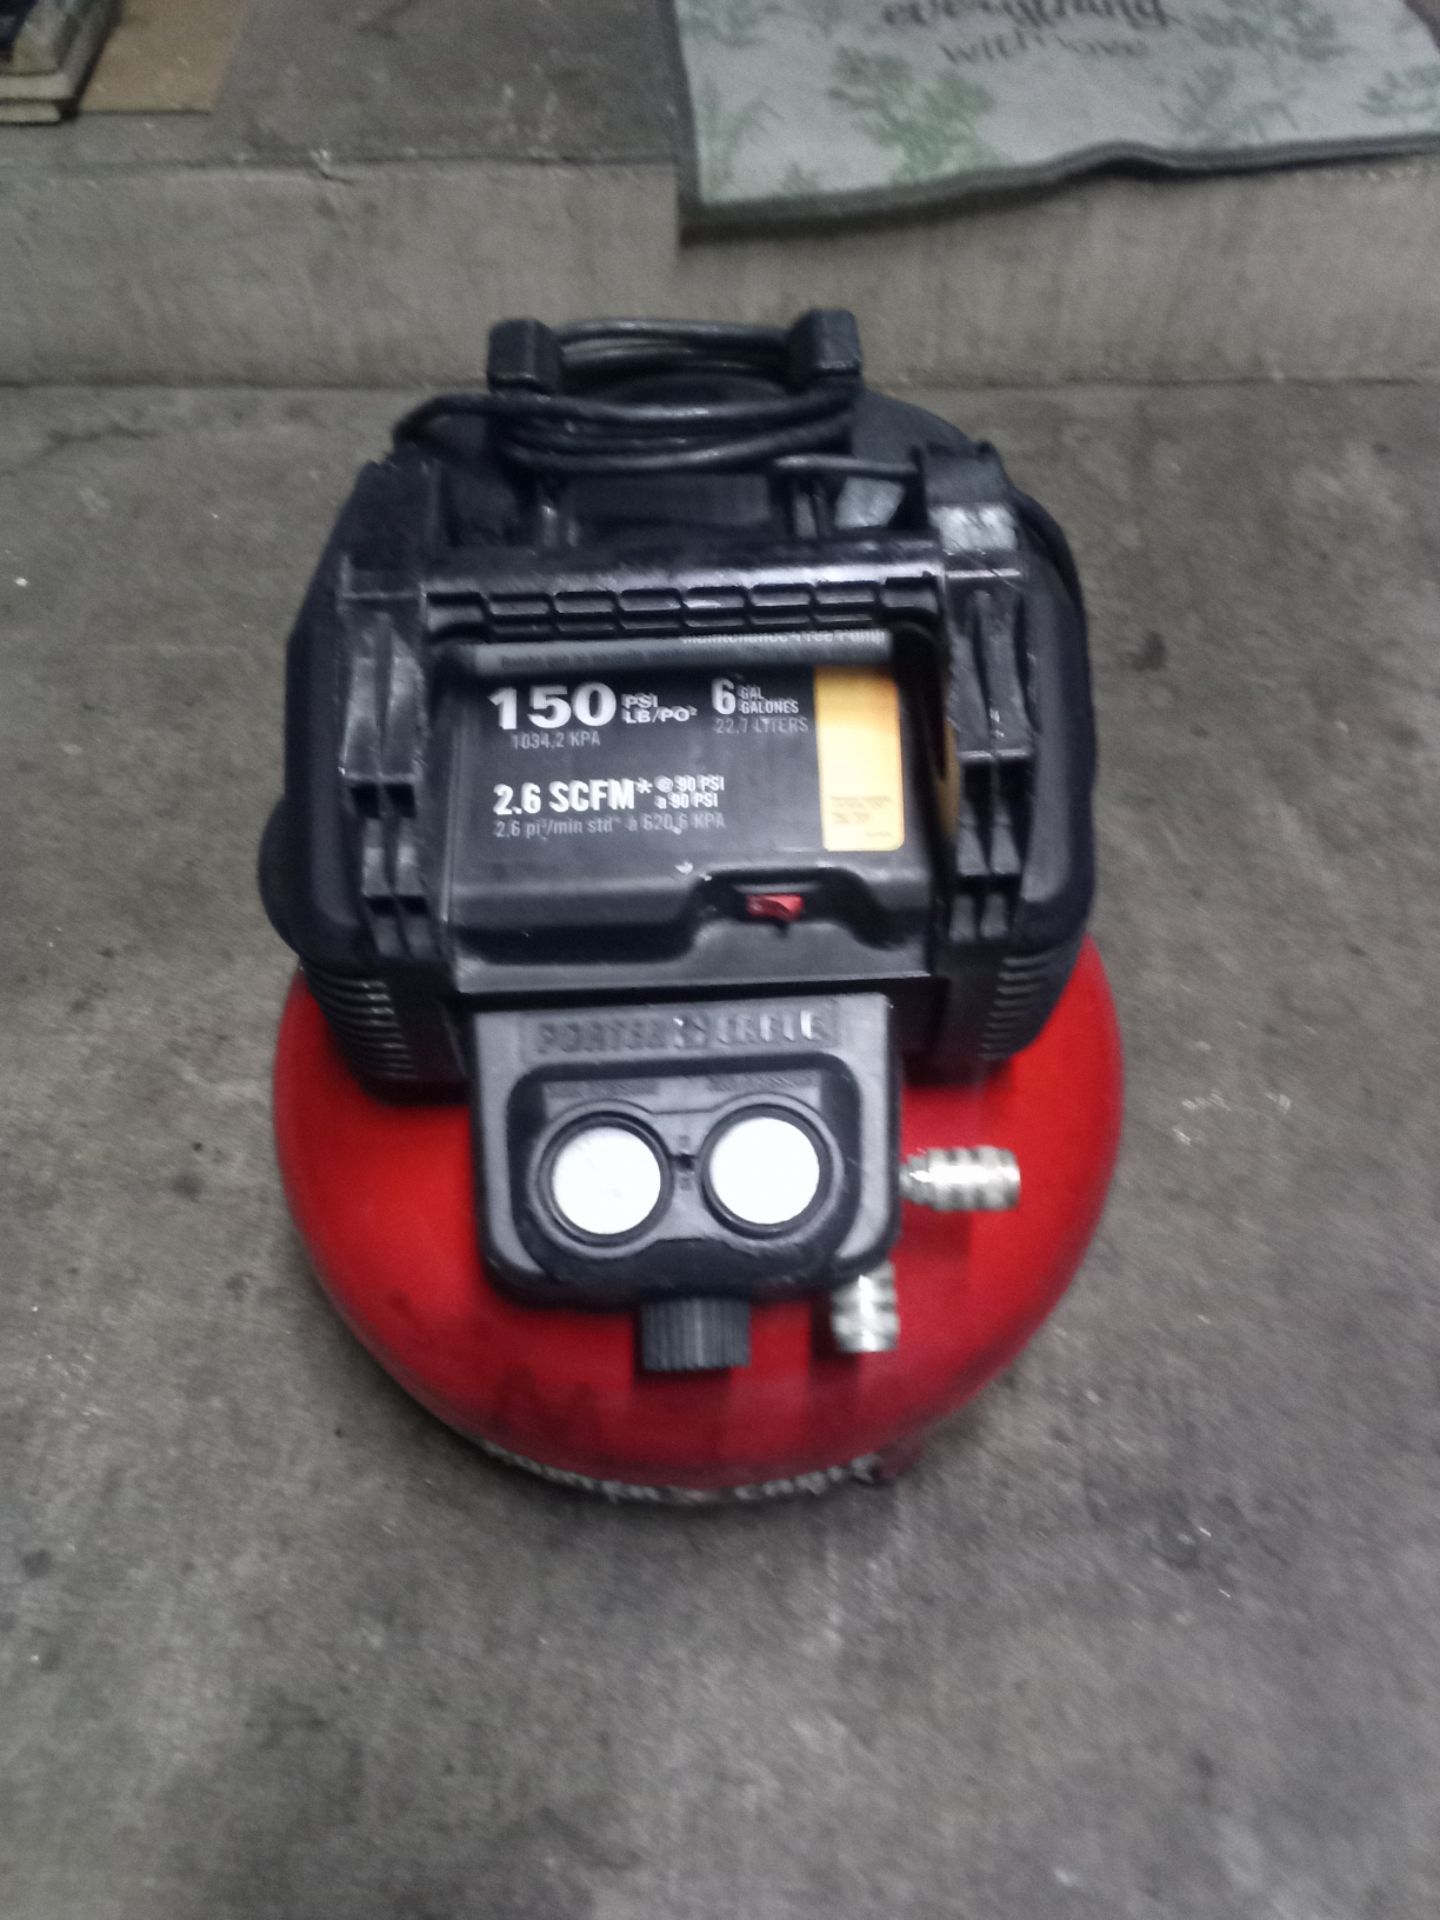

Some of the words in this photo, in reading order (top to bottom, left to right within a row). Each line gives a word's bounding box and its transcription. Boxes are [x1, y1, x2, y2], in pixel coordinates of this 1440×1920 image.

[621, 693, 658, 709] PSI
[712, 678, 736, 715] 6
[737, 685, 766, 700] GAL
[488, 682, 617, 730] 150
[738, 698, 799, 714] GALONES
[569, 731, 600, 747] KPA
[674, 774, 696, 792] 90
[697, 773, 725, 791] PSI
[493, 783, 541, 815] 2.6
[668, 791, 689, 809] 90
[691, 790, 718, 808] PSI
[691, 810, 726, 830] KPA
